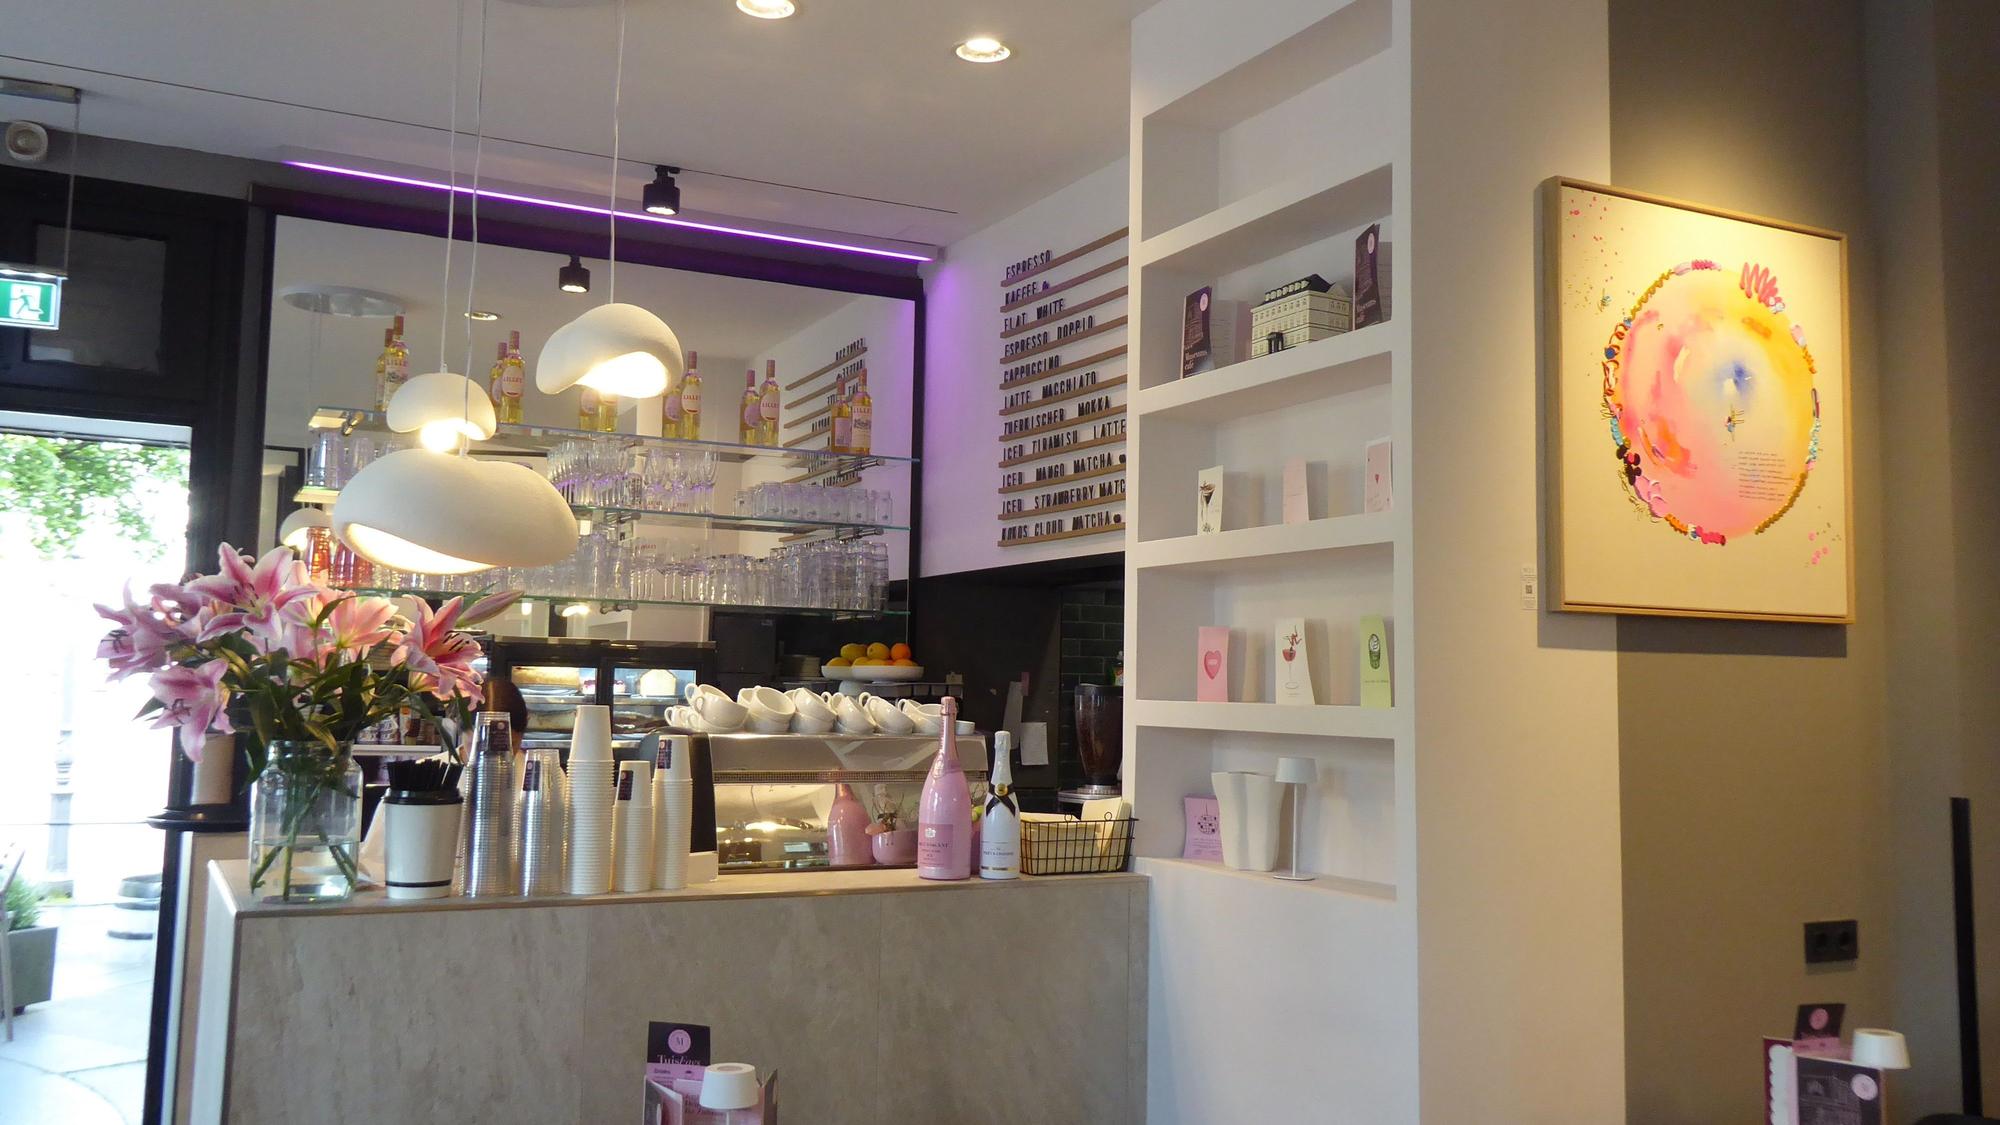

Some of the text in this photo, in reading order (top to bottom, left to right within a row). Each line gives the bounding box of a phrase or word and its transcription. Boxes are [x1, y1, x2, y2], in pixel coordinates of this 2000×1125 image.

[1005, 250, 1051, 279] ESPRESSO
[1005, 282, 1037, 306] KAFFEE
[1004, 298, 1064, 332] FLAT WHITE
[1004, 315, 1094, 357] ESPRESSO DOPPIO
[1003, 355, 1060, 383] CAPPUCCINO
[1004, 371, 1097, 410] LATTE MACCHIATO
[1003, 396, 1111, 435] TUERKISCHER MOKKA
[1003, 419, 1126, 461] ICED TIRAMISU LATTE
[1002, 452, 1112, 488] ICED MANGO MATCHA
[1002, 499, 1023, 514] ICED
[1034, 485, 1095, 509] STRAWBERRY
[1001, 511, 1110, 541] KOKOS CLOUD MATCHA
